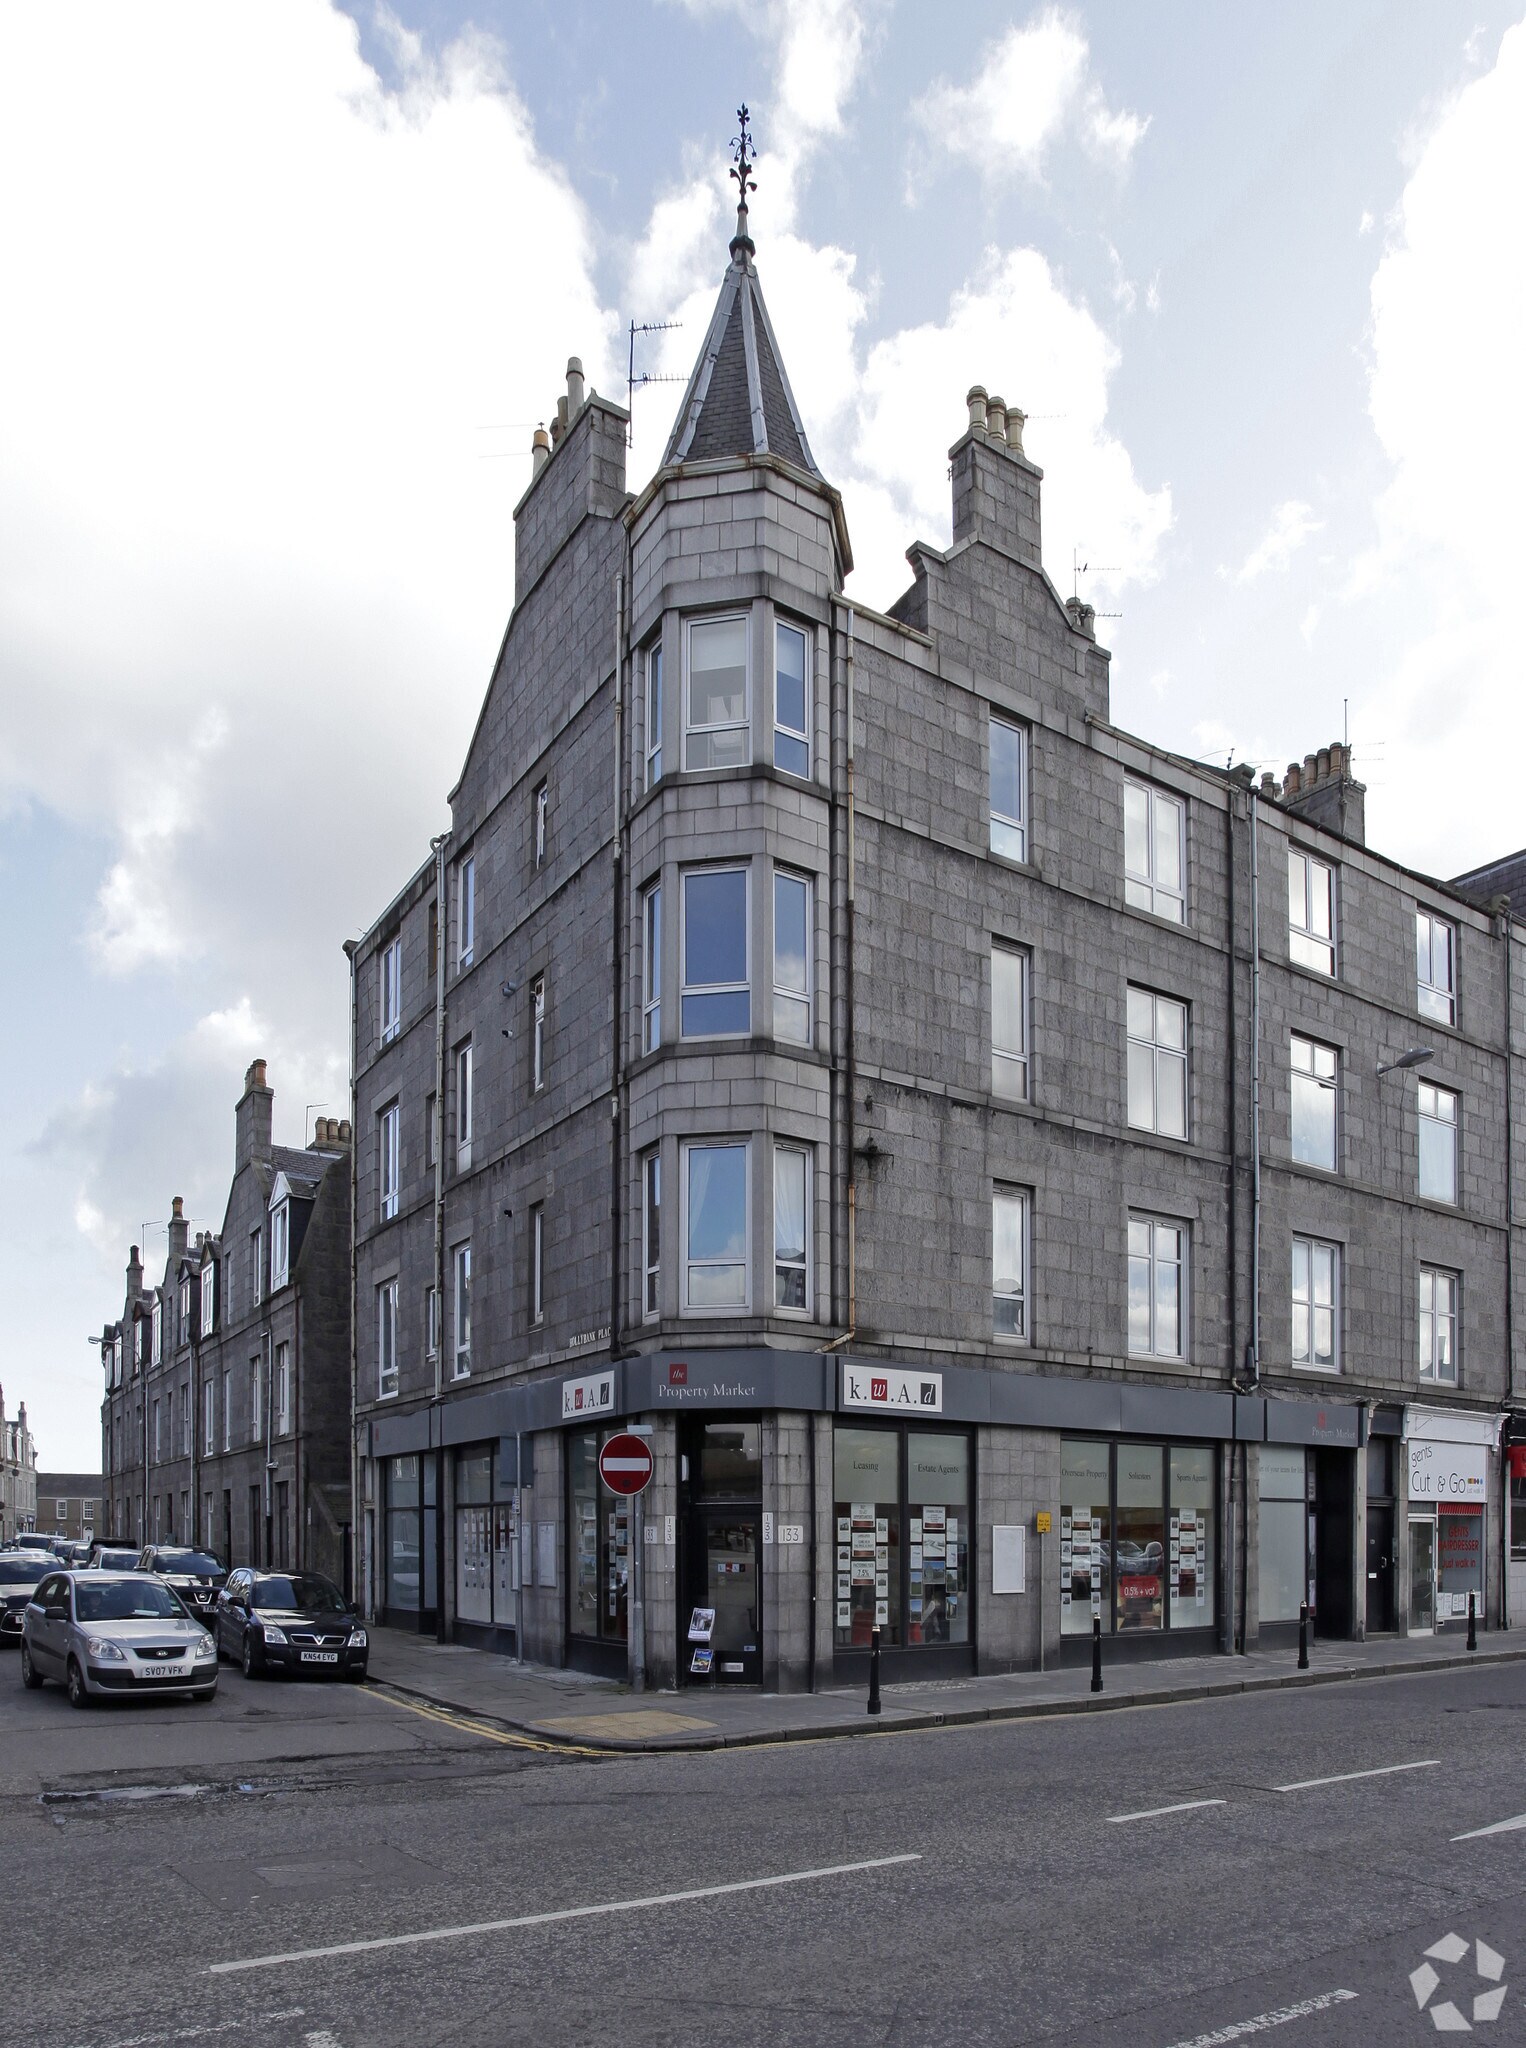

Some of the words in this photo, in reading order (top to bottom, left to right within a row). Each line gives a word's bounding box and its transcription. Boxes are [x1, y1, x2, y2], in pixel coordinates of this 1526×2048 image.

[569, 1331, 596, 1348] HOLLYBANK
[598, 1326, 611, 1340] PLAC
[659, 1384, 709, 1400] Property
[713, 1383, 756, 1396] Market
[1411, 1445, 1433, 1468] gents
[853, 1461, 879, 1472] Leasing
[917, 1464, 936, 1473] Estate
[937, 1465, 959, 1475] Agents
[1061, 1469, 1085, 1477] Overseas
[1086, 1470, 1107, 1480] Property
[1412, 1471, 1431, 1492] Cut
[1437, 1475, 1446, 1493] &
[1449, 1473, 1466, 1493] Go
[783, 1528, 799, 1542] 133
[1448, 1526, 1469, 1538] GENTS
[1124, 1587, 1138, 1596] 0.5%
[1145, 1587, 1155, 1596] vat
[303, 1653, 321, 1661] KN54
[322, 1653, 336, 1661] EYG
[145, 1667, 166, 1676] SV07
[169, 1666, 183, 1675] VFK
